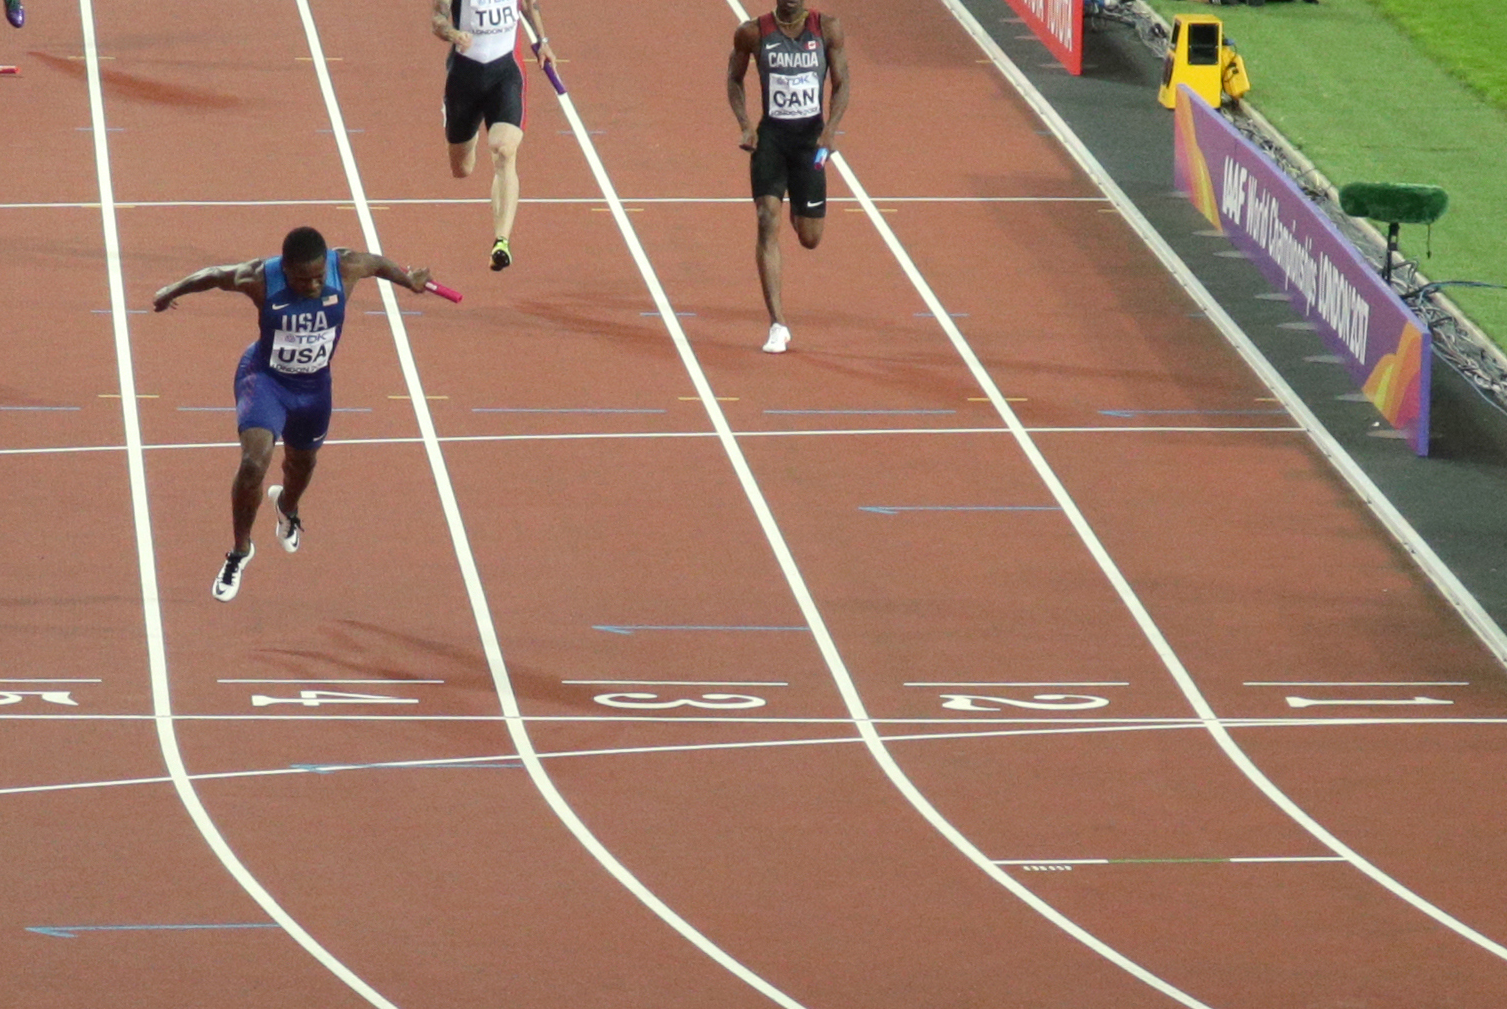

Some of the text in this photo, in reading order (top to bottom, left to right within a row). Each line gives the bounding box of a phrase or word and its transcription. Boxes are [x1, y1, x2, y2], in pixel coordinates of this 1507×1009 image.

[475, 6, 514, 27] TUR
[768, 52, 819, 68] CANADA
[773, 88, 814, 108] CAN
[1222, 155, 1248, 225] IAAF
[1246, 174, 1271, 249] World
[282, 311, 328, 332] USA
[295, 334, 326, 344] TDK
[278, 344, 327, 364] USA
[251, 690, 419, 707] 4
[593, 692, 766, 709] 3
[939, 694, 1111, 711] 2
[1284, 696, 1455, 708] 1
